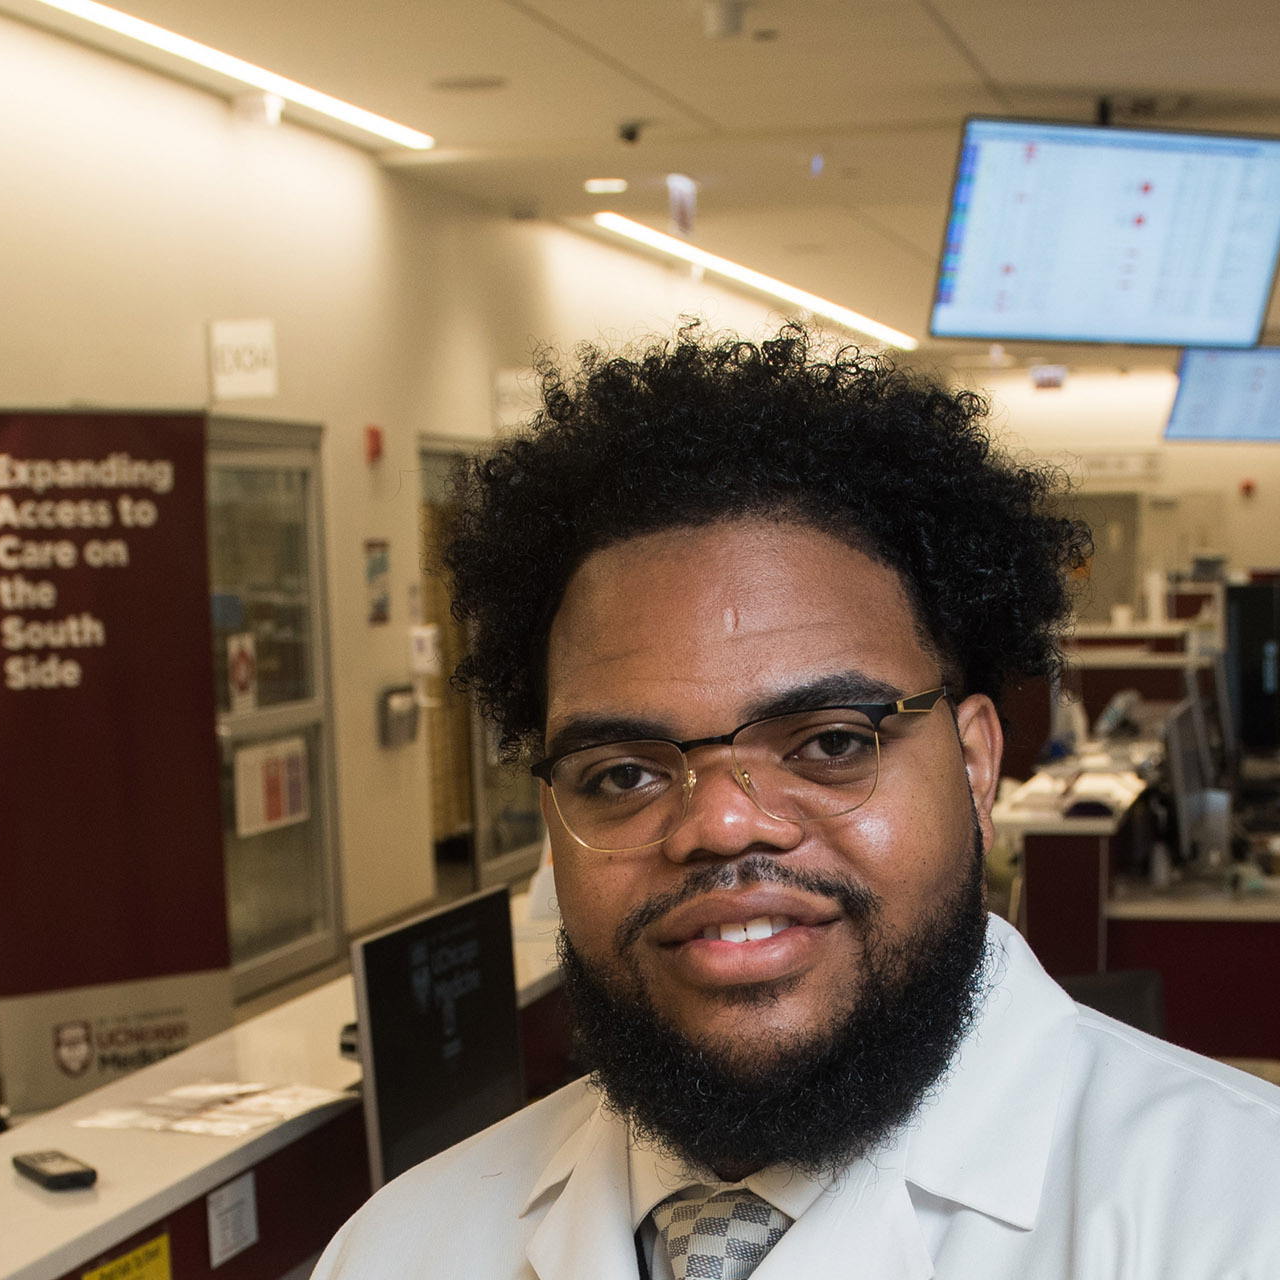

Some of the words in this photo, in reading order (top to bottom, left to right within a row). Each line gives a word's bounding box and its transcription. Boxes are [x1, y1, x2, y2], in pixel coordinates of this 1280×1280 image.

[117, 494, 158, 528] to
[82, 539, 130, 568] on
[0, 612, 106, 650] South
[4, 654, 82, 690] Side
